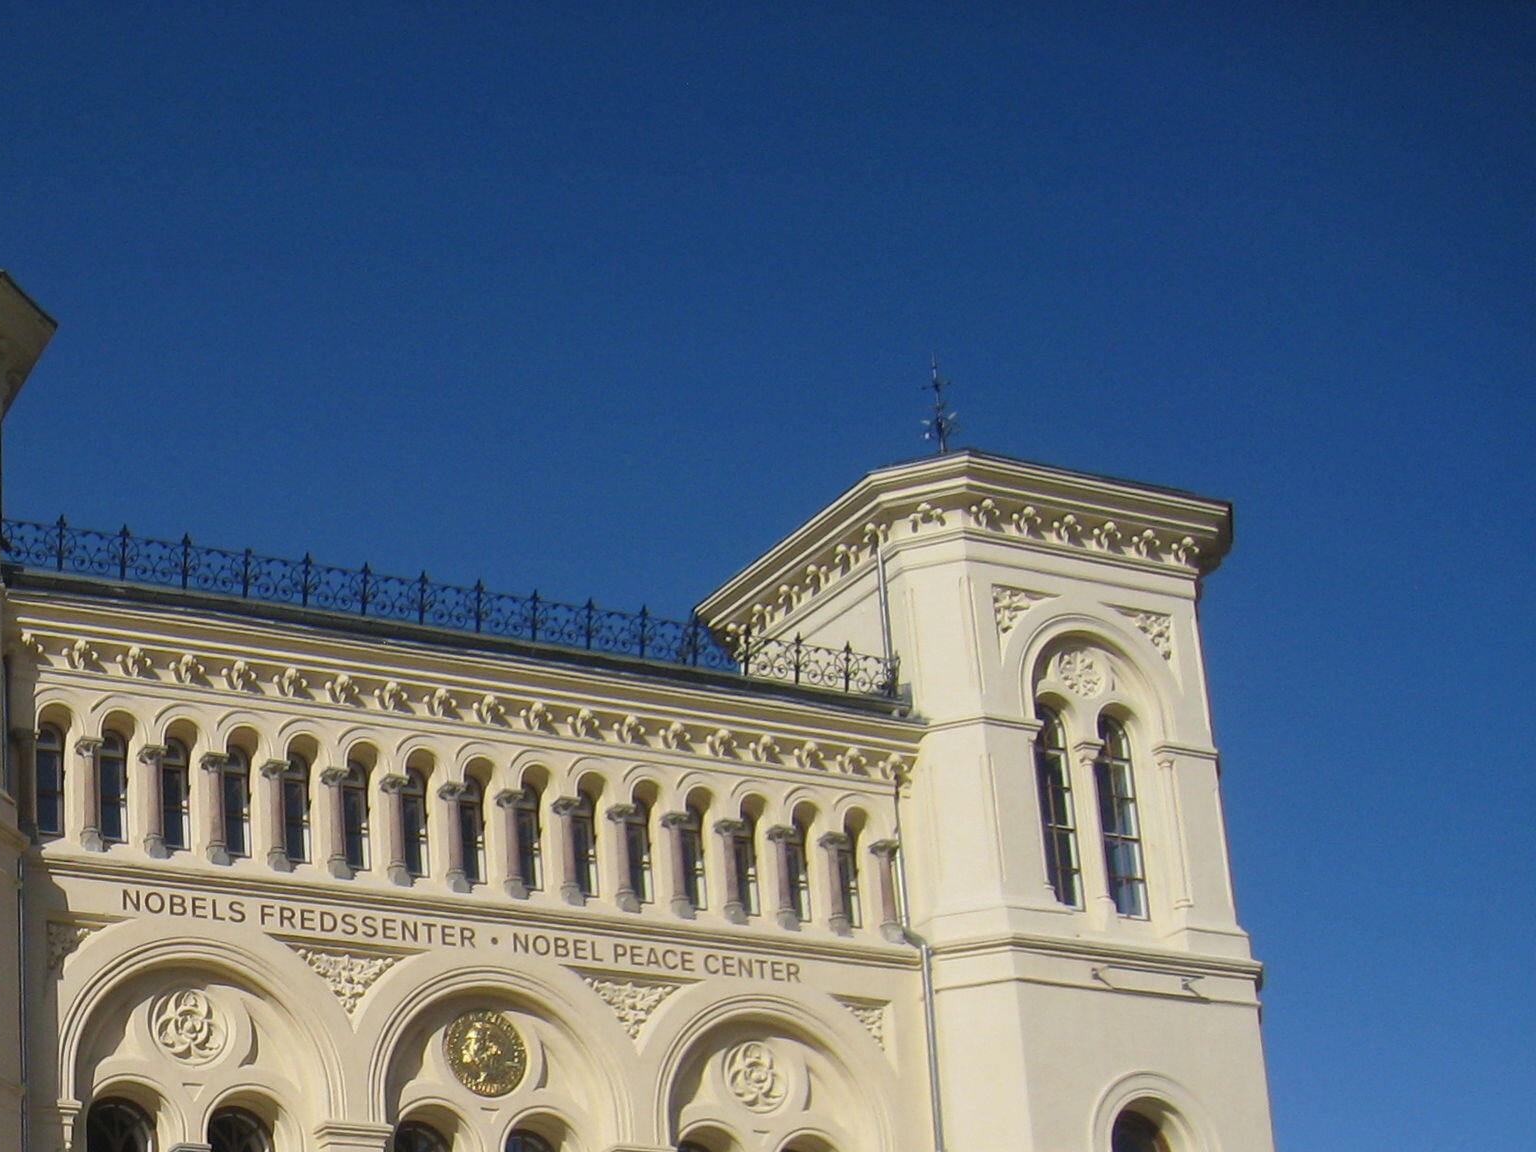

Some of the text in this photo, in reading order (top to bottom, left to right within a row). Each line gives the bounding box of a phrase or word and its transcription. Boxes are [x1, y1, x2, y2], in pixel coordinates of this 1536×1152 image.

[121, 888, 802, 983] NOBELS FREDSSENTER NOBEL PEACE CENTER
